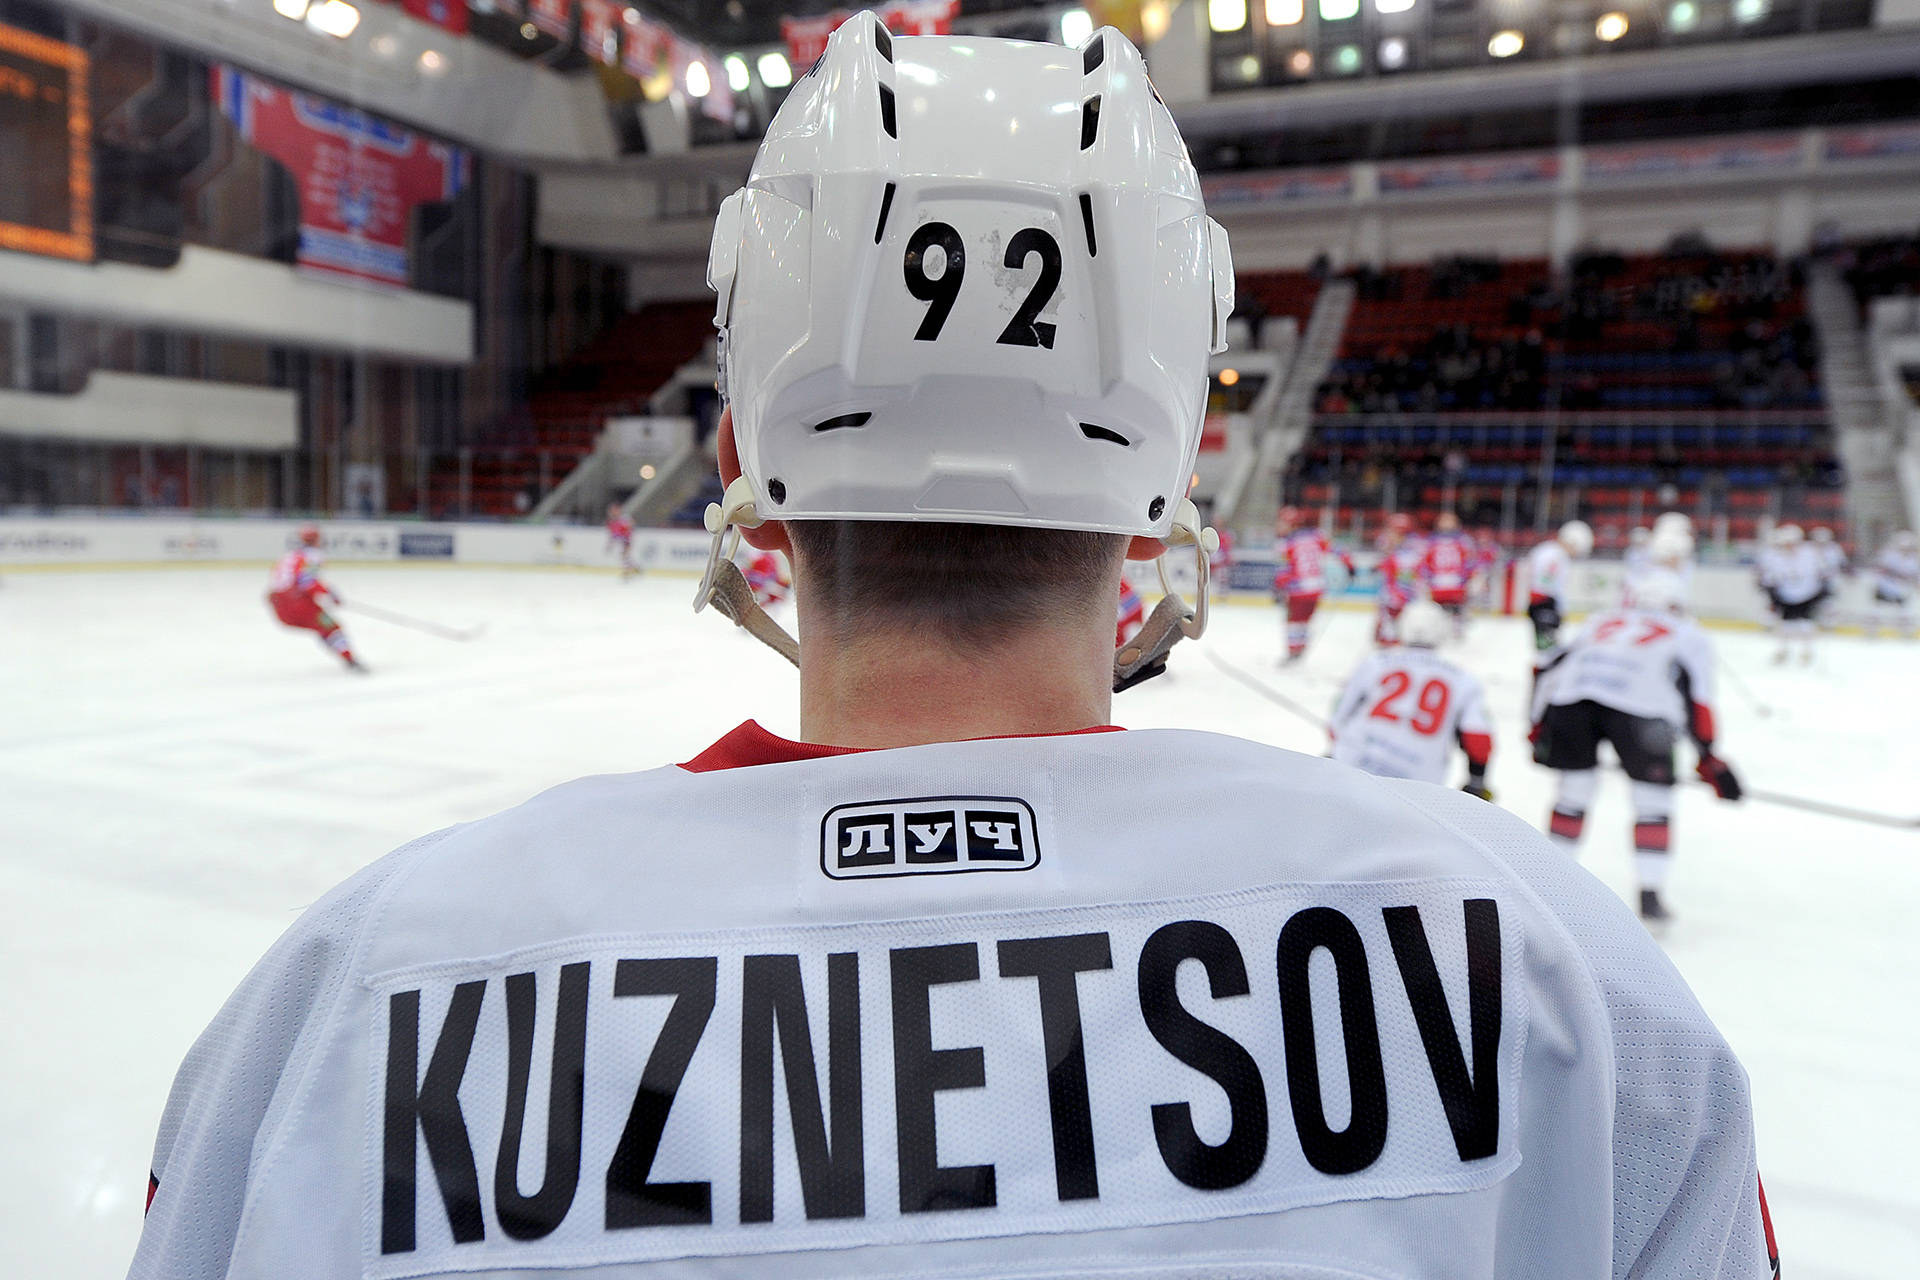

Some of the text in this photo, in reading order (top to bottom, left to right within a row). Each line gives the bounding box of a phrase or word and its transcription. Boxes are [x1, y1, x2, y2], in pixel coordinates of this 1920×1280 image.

[903, 221, 1064, 350] 92
[1369, 670, 1452, 736] 29
[381, 898, 1503, 1255] KUZNETSOV
